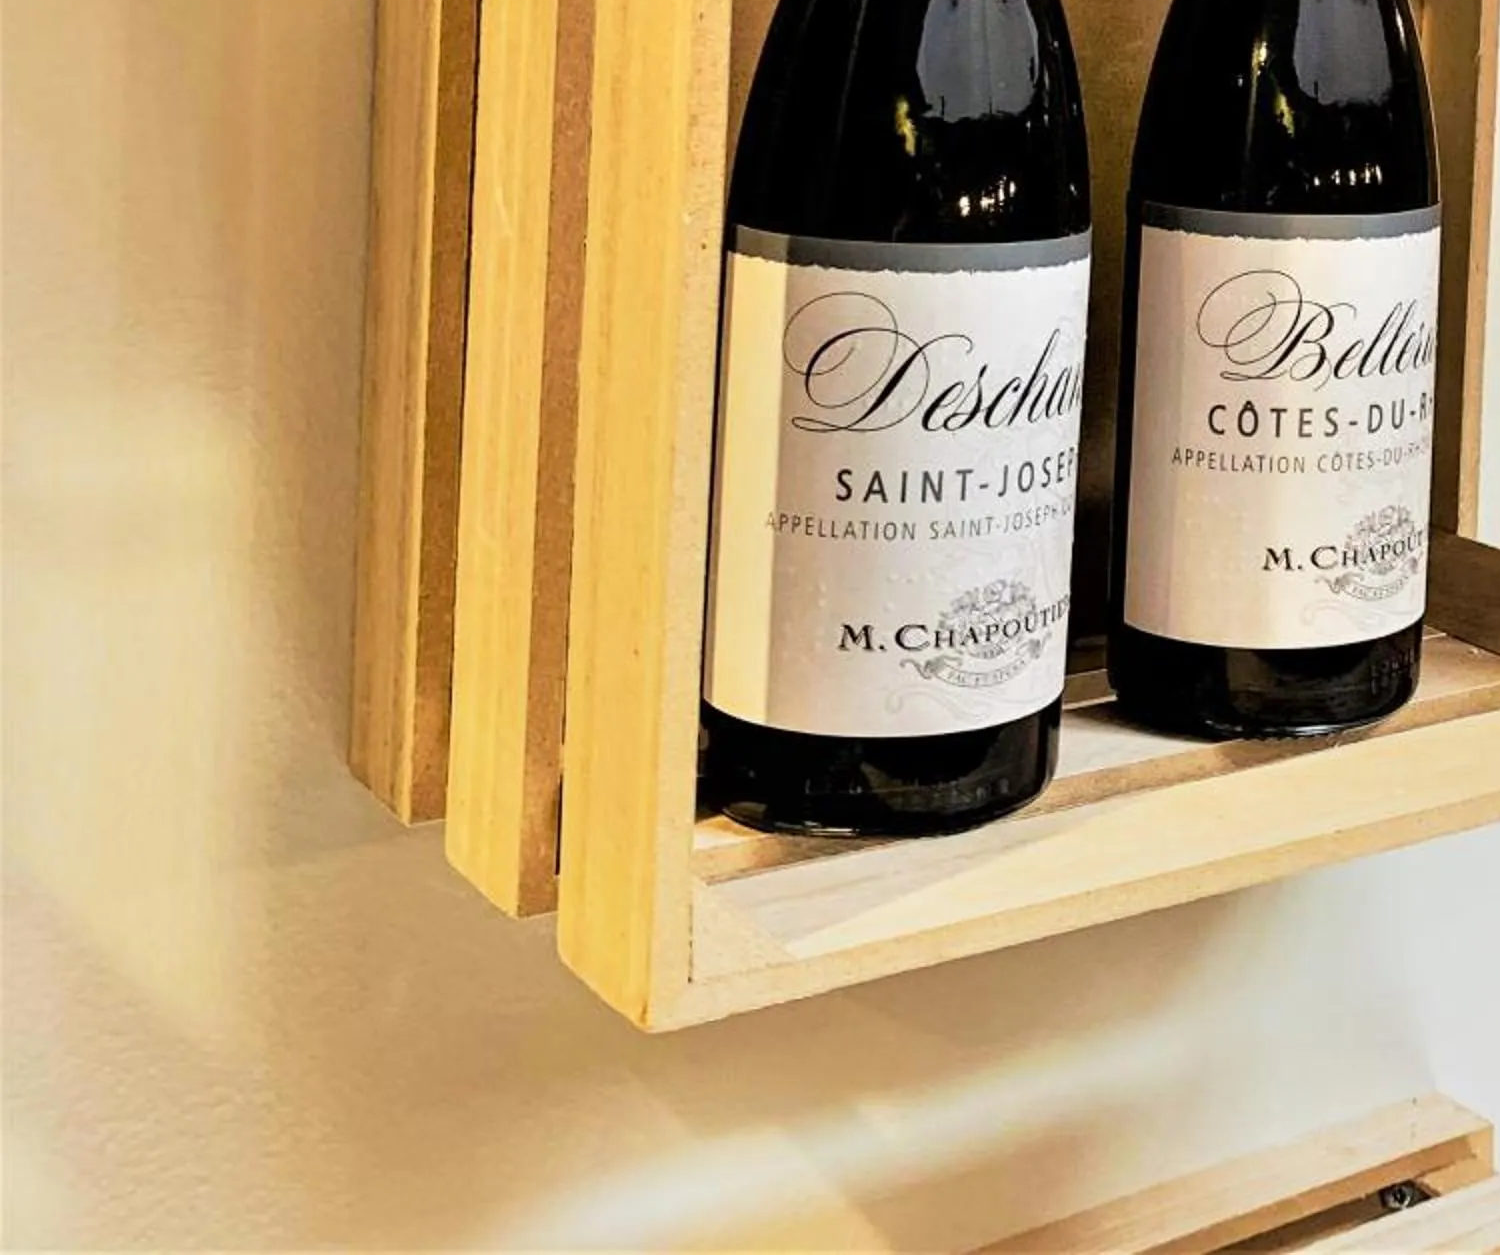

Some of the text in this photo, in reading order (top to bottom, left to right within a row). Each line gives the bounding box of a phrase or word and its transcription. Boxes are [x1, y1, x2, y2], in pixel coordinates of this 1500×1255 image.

[1171, 447, 1306, 475] APPELLATION
[765, 511, 917, 542] APPELLATION
[1262, 546, 1303, 572] M.
[838, 623, 885, 653] M.
